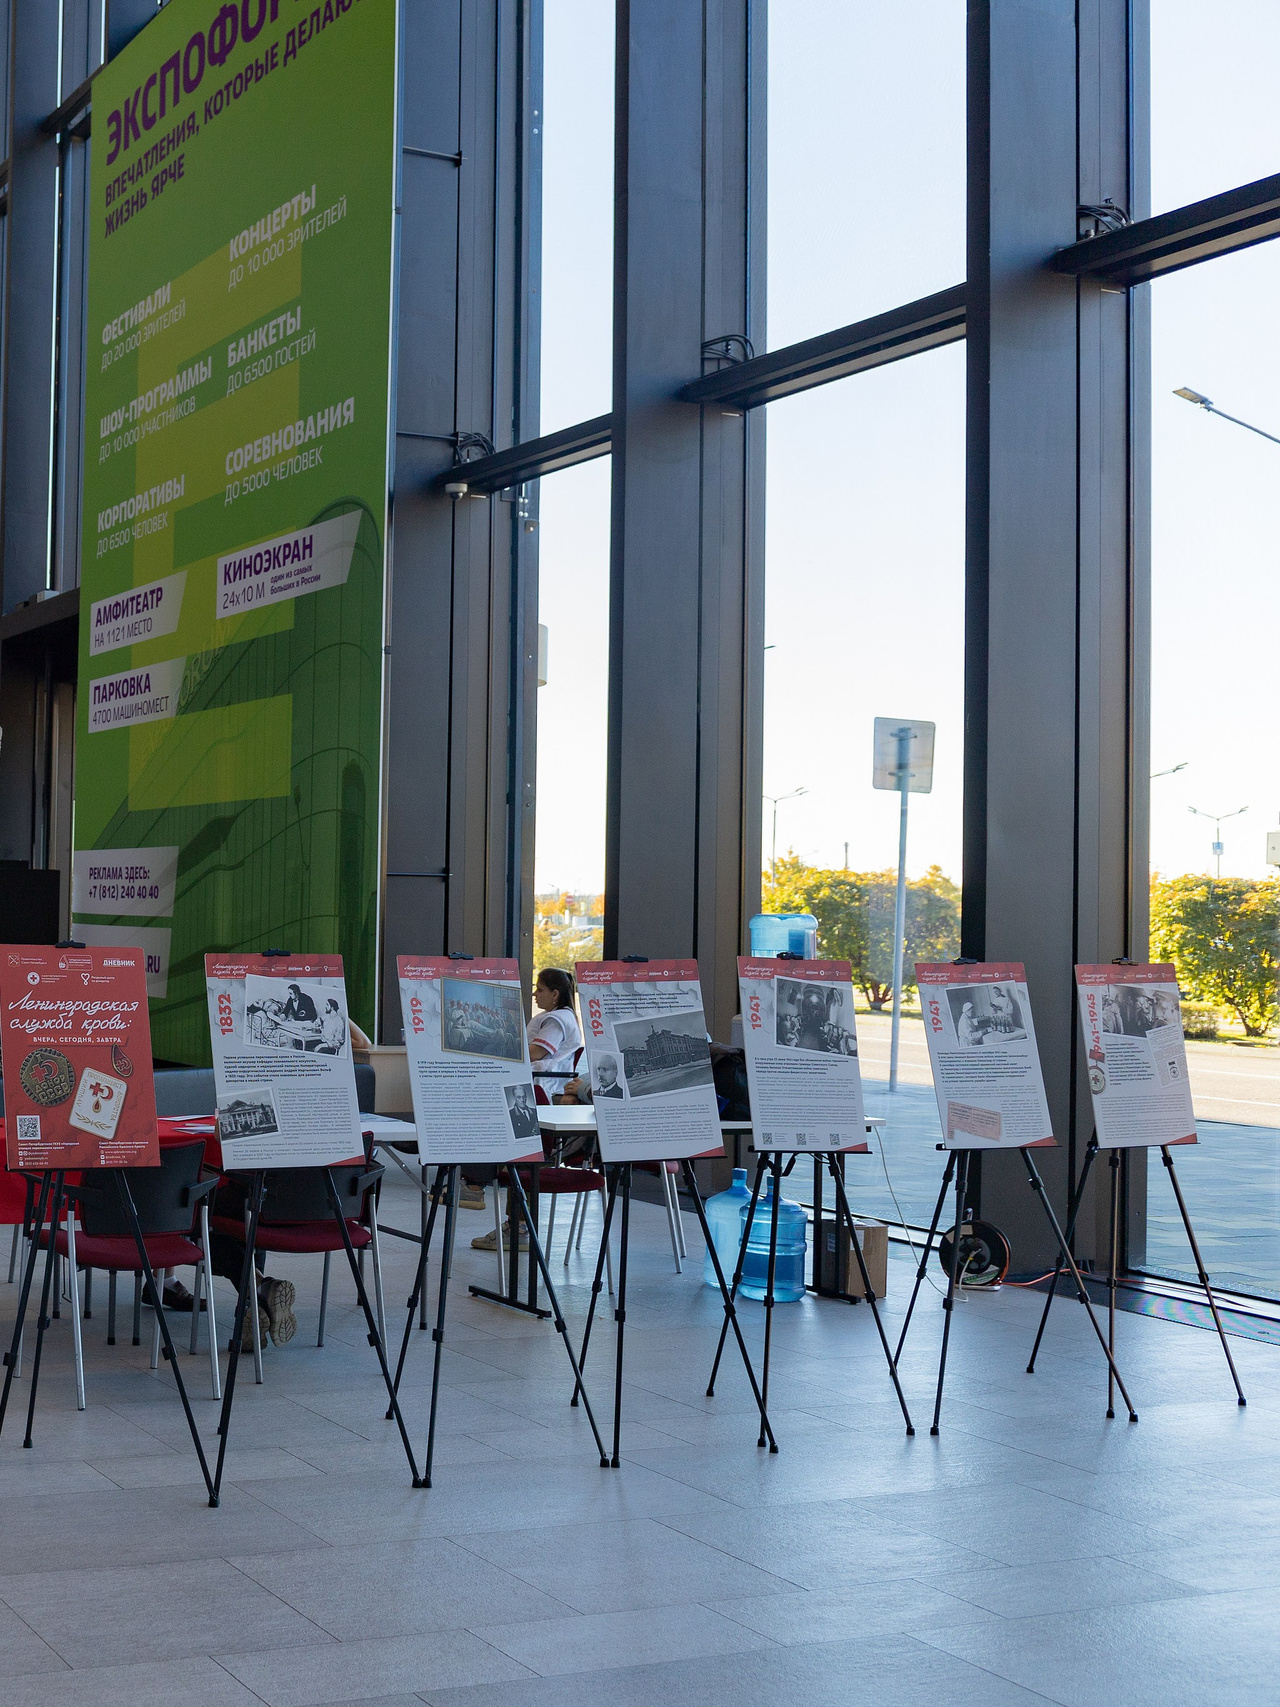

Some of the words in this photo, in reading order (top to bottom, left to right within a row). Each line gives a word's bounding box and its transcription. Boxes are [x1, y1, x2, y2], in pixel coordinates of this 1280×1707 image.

[105, 111, 199, 208] ВПЕЧАТЛЕНИЯ,
[204, 42, 278, 124] КОТОРЫЕ
[283, 0, 360, 67] ДЕЛАЮ
[107, 0, 296, 166] ЭКСПОФО
[105, 187, 147, 238] ЖИЗНЬ
[151, 153, 185, 200] ЯРЧЕ
[228, 264, 243, 293] ДО
[248, 254, 260, 274] 10
[262, 239, 284, 265] 000
[287, 194, 346, 251] ЗРИТЕЛЕЙ
[229, 184, 315, 261] КОНЦЕРТЫ
[102, 282, 170, 345] ФЕСТИВАЛИ
[101, 353, 112, 373] ДО
[114, 342, 125, 360] 20
[126, 333, 141, 354] 000
[143, 297, 185, 343] ЗРИТЕЛЕЙ
[228, 306, 301, 367] БАНКЕТЫ
[227, 373, 241, 397] ДО
[244, 355, 272, 384] 6500
[275, 327, 315, 370] ГОСТЕЙ
[101, 356, 211, 438] ШОУ-ПРОГРАММЫ
[99, 445, 110, 465] ДО
[113, 435, 122, 452] 10
[124, 427, 139, 447] 000
[141, 396, 195, 440] УЧАСТНИКОВ
[225, 397, 354, 475] СОРЕВНОВАНИЯ
[225, 481, 240, 506] ДО
[242, 468, 270, 495] 5000
[273, 446, 322, 481] ЧЕЛОВЕК
[98, 474, 185, 533] КОРПОРАТИВЫ
[97, 539, 108, 559] ДО
[110, 528, 130, 549] 6500
[132, 511, 168, 540] ЧЕЛОВЕК
[224, 534, 313, 585] КИНОЭКРАН
[271, 574, 284, 584] один
[294, 565, 312, 577] самых
[256, 582, 265, 599] М
[270, 583, 293, 595] больших
[301, 574, 320, 586] России
[95, 587, 163, 627] АМФИТЕАТР
[95, 633, 104, 648] НА
[107, 627, 125, 644] 1121
[127, 618, 152, 639] МЕСТО
[94, 673, 151, 704] ПАРКОВКА
[93, 710, 111, 725] 4700
[114, 696, 169, 720] МАШИНОМЕСТ
[89, 867, 122, 880] РЕКЛАМА
[125, 866, 150, 883] ЗДЕСЬ:
[89, 886, 97, 898] +7
[99, 885, 119, 900] (812)
[121, 886, 135, 898] 240
[137, 886, 147, 898] 40
[149, 886, 159, 899] 40
[103, 959, 135, 967] ДНЕВНИК
[9, 990, 139, 1017] Ленинградская
[10, 1013, 72, 1034] служба
[82, 1014, 132, 1035] крови:
[218, 993, 233, 1035] 1832
[410, 998, 424, 1034] 1919
[589, 999, 604, 1037] 1932
[749, 996, 761, 1030] 1941
[929, 1000, 943, 1032] 1941
[1087, 994, 1101, 1051] 941–1945
[36, 1076, 66, 1094] ДОНОР
